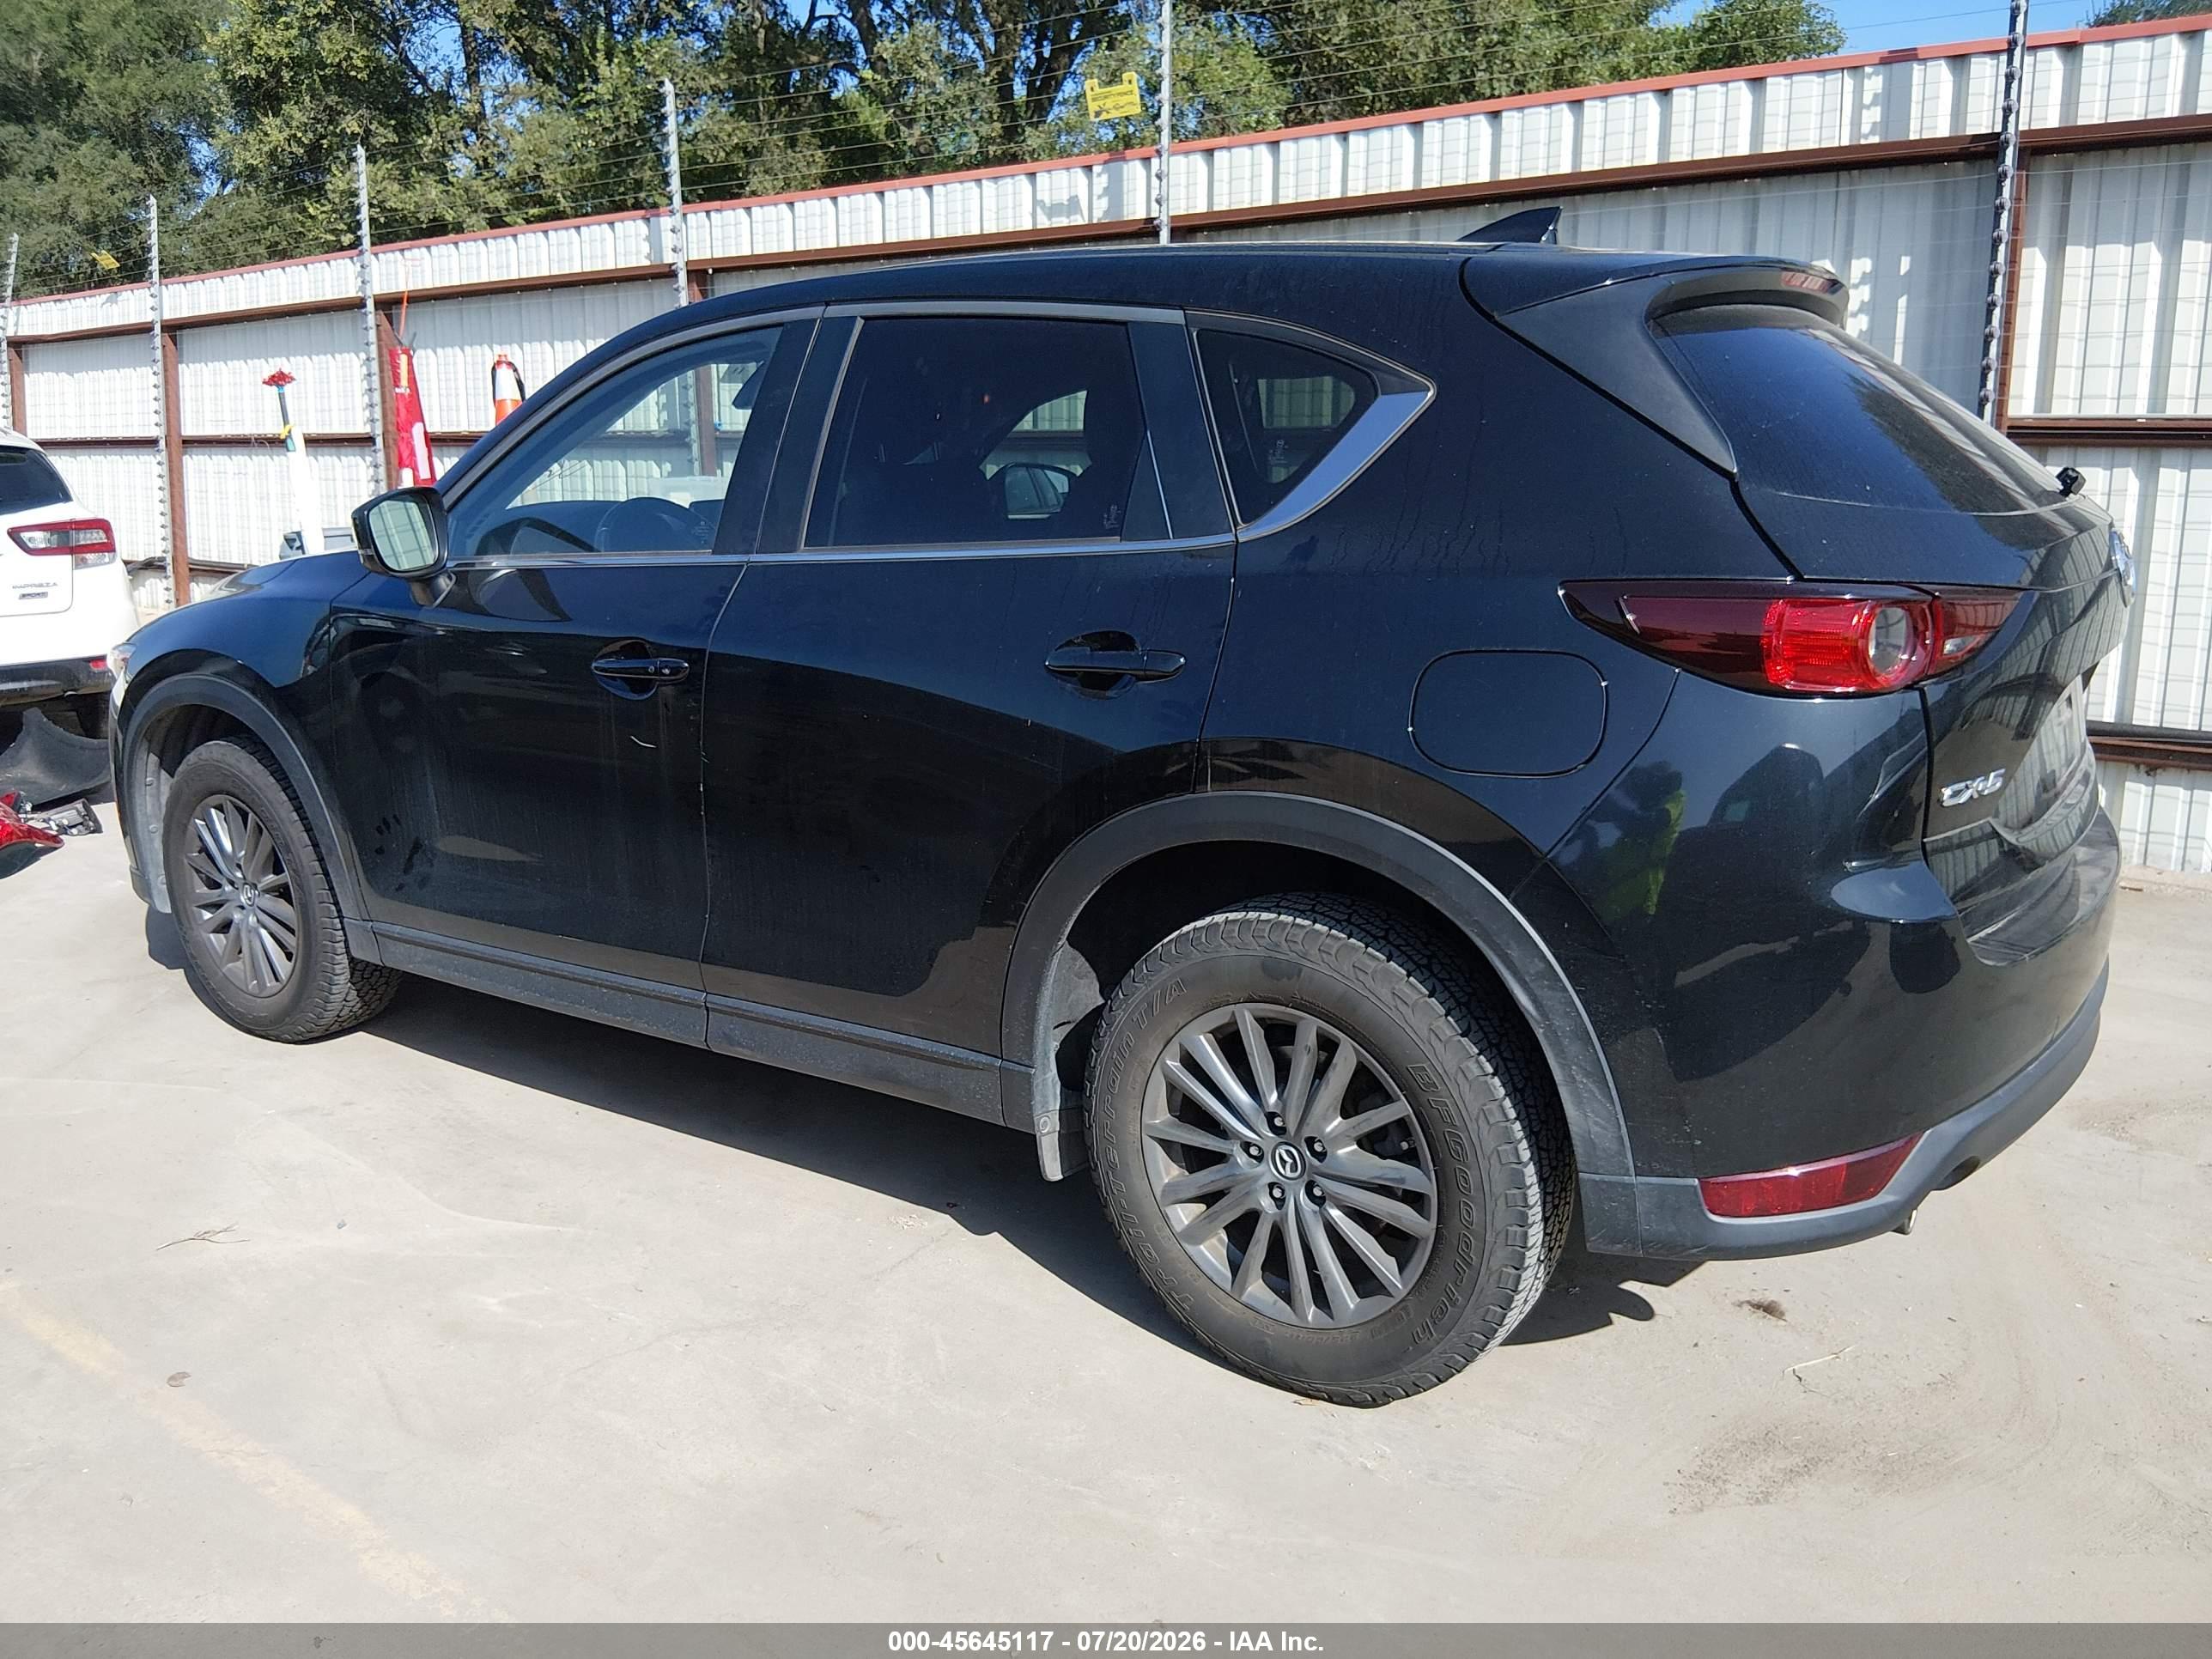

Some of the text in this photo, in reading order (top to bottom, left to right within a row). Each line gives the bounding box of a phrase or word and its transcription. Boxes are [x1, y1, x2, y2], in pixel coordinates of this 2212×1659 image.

[1940, 768, 2006, 807] CX-5
[1133, 977, 1188, 1030] T/A
[1407, 1064, 1475, 1345] BFGoodrich
